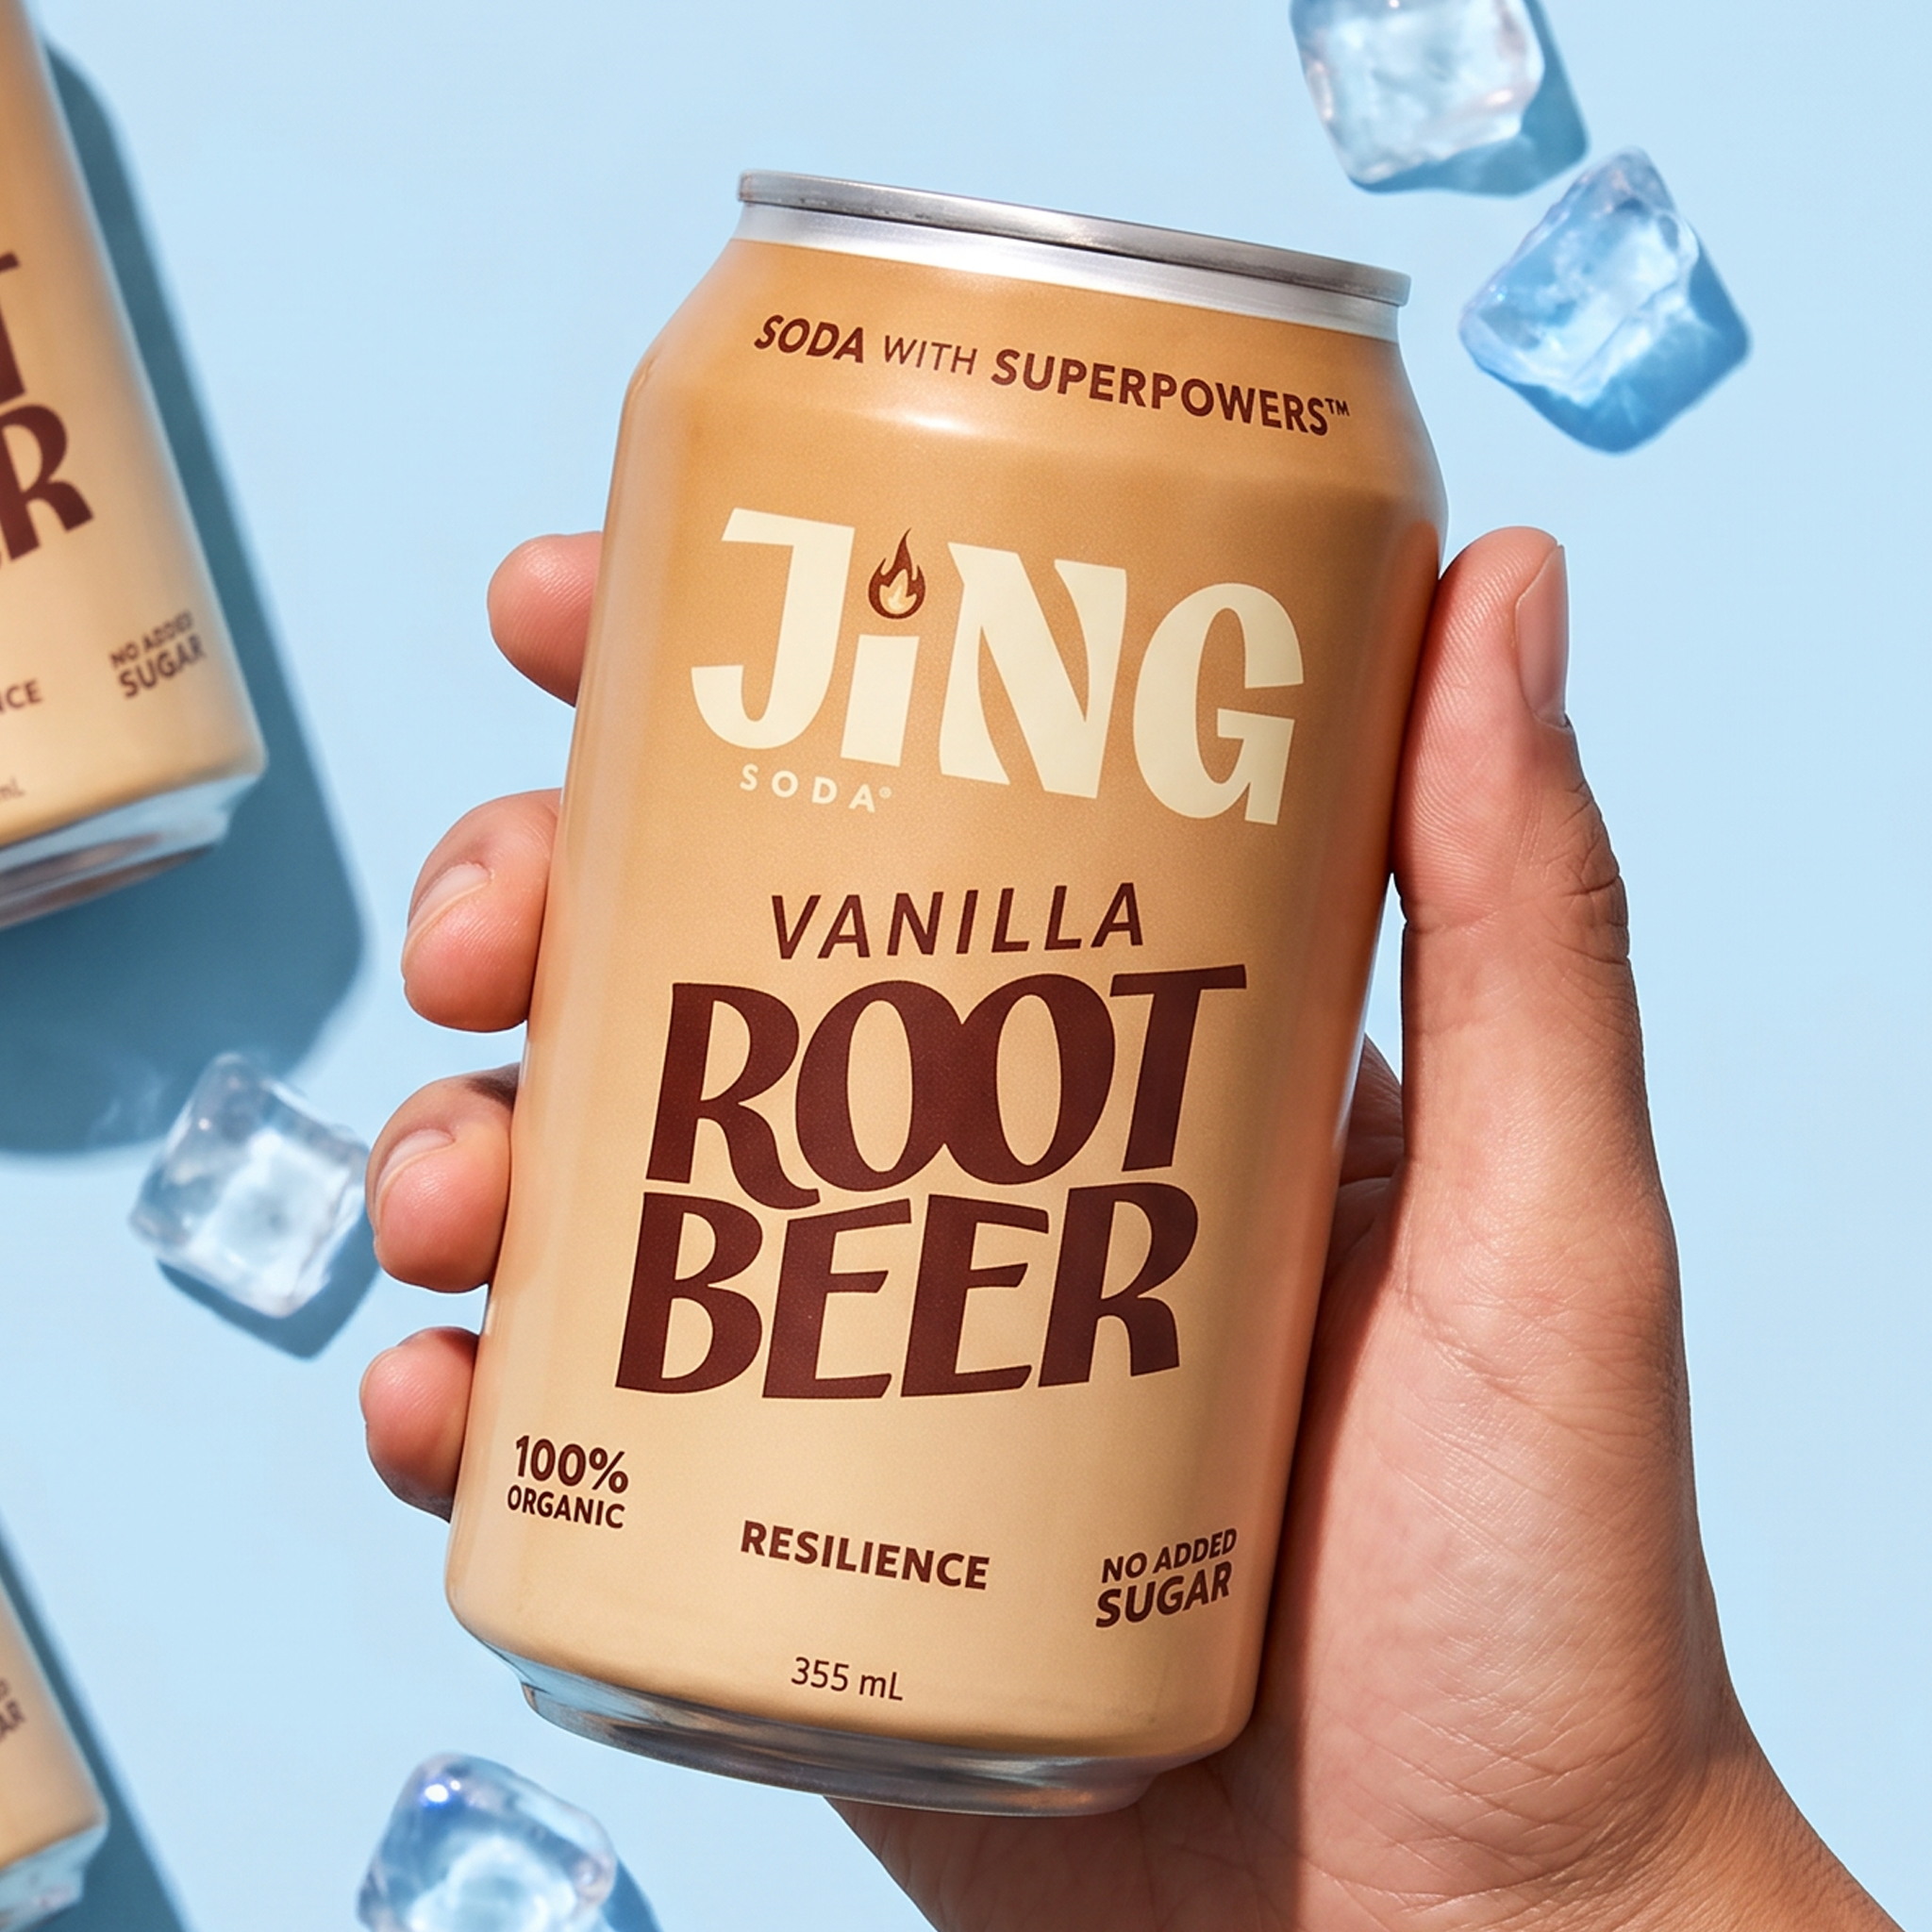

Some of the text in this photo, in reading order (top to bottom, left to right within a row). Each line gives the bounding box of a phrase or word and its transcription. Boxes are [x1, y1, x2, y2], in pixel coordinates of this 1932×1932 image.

[754, 314, 864, 364] SODA
[884, 335, 978, 375] WITH
[0, 404, 94, 562] R
[119, 634, 206, 698] SUGAR
[771, 882, 1144, 960] VANILLA
[645, 964, 1247, 1210] ROOT
[615, 1182, 1199, 1399] BEER
[515, 1435, 629, 1494] 100%
[508, 1485, 625, 1529] ORGANIC
[741, 1520, 991, 1591] RESILIENCE
[1101, 1527, 1238, 1584] NO ADDED
[1095, 1560, 1233, 1628] SUGAR
[791, 1657, 904, 1702] 355 mL
